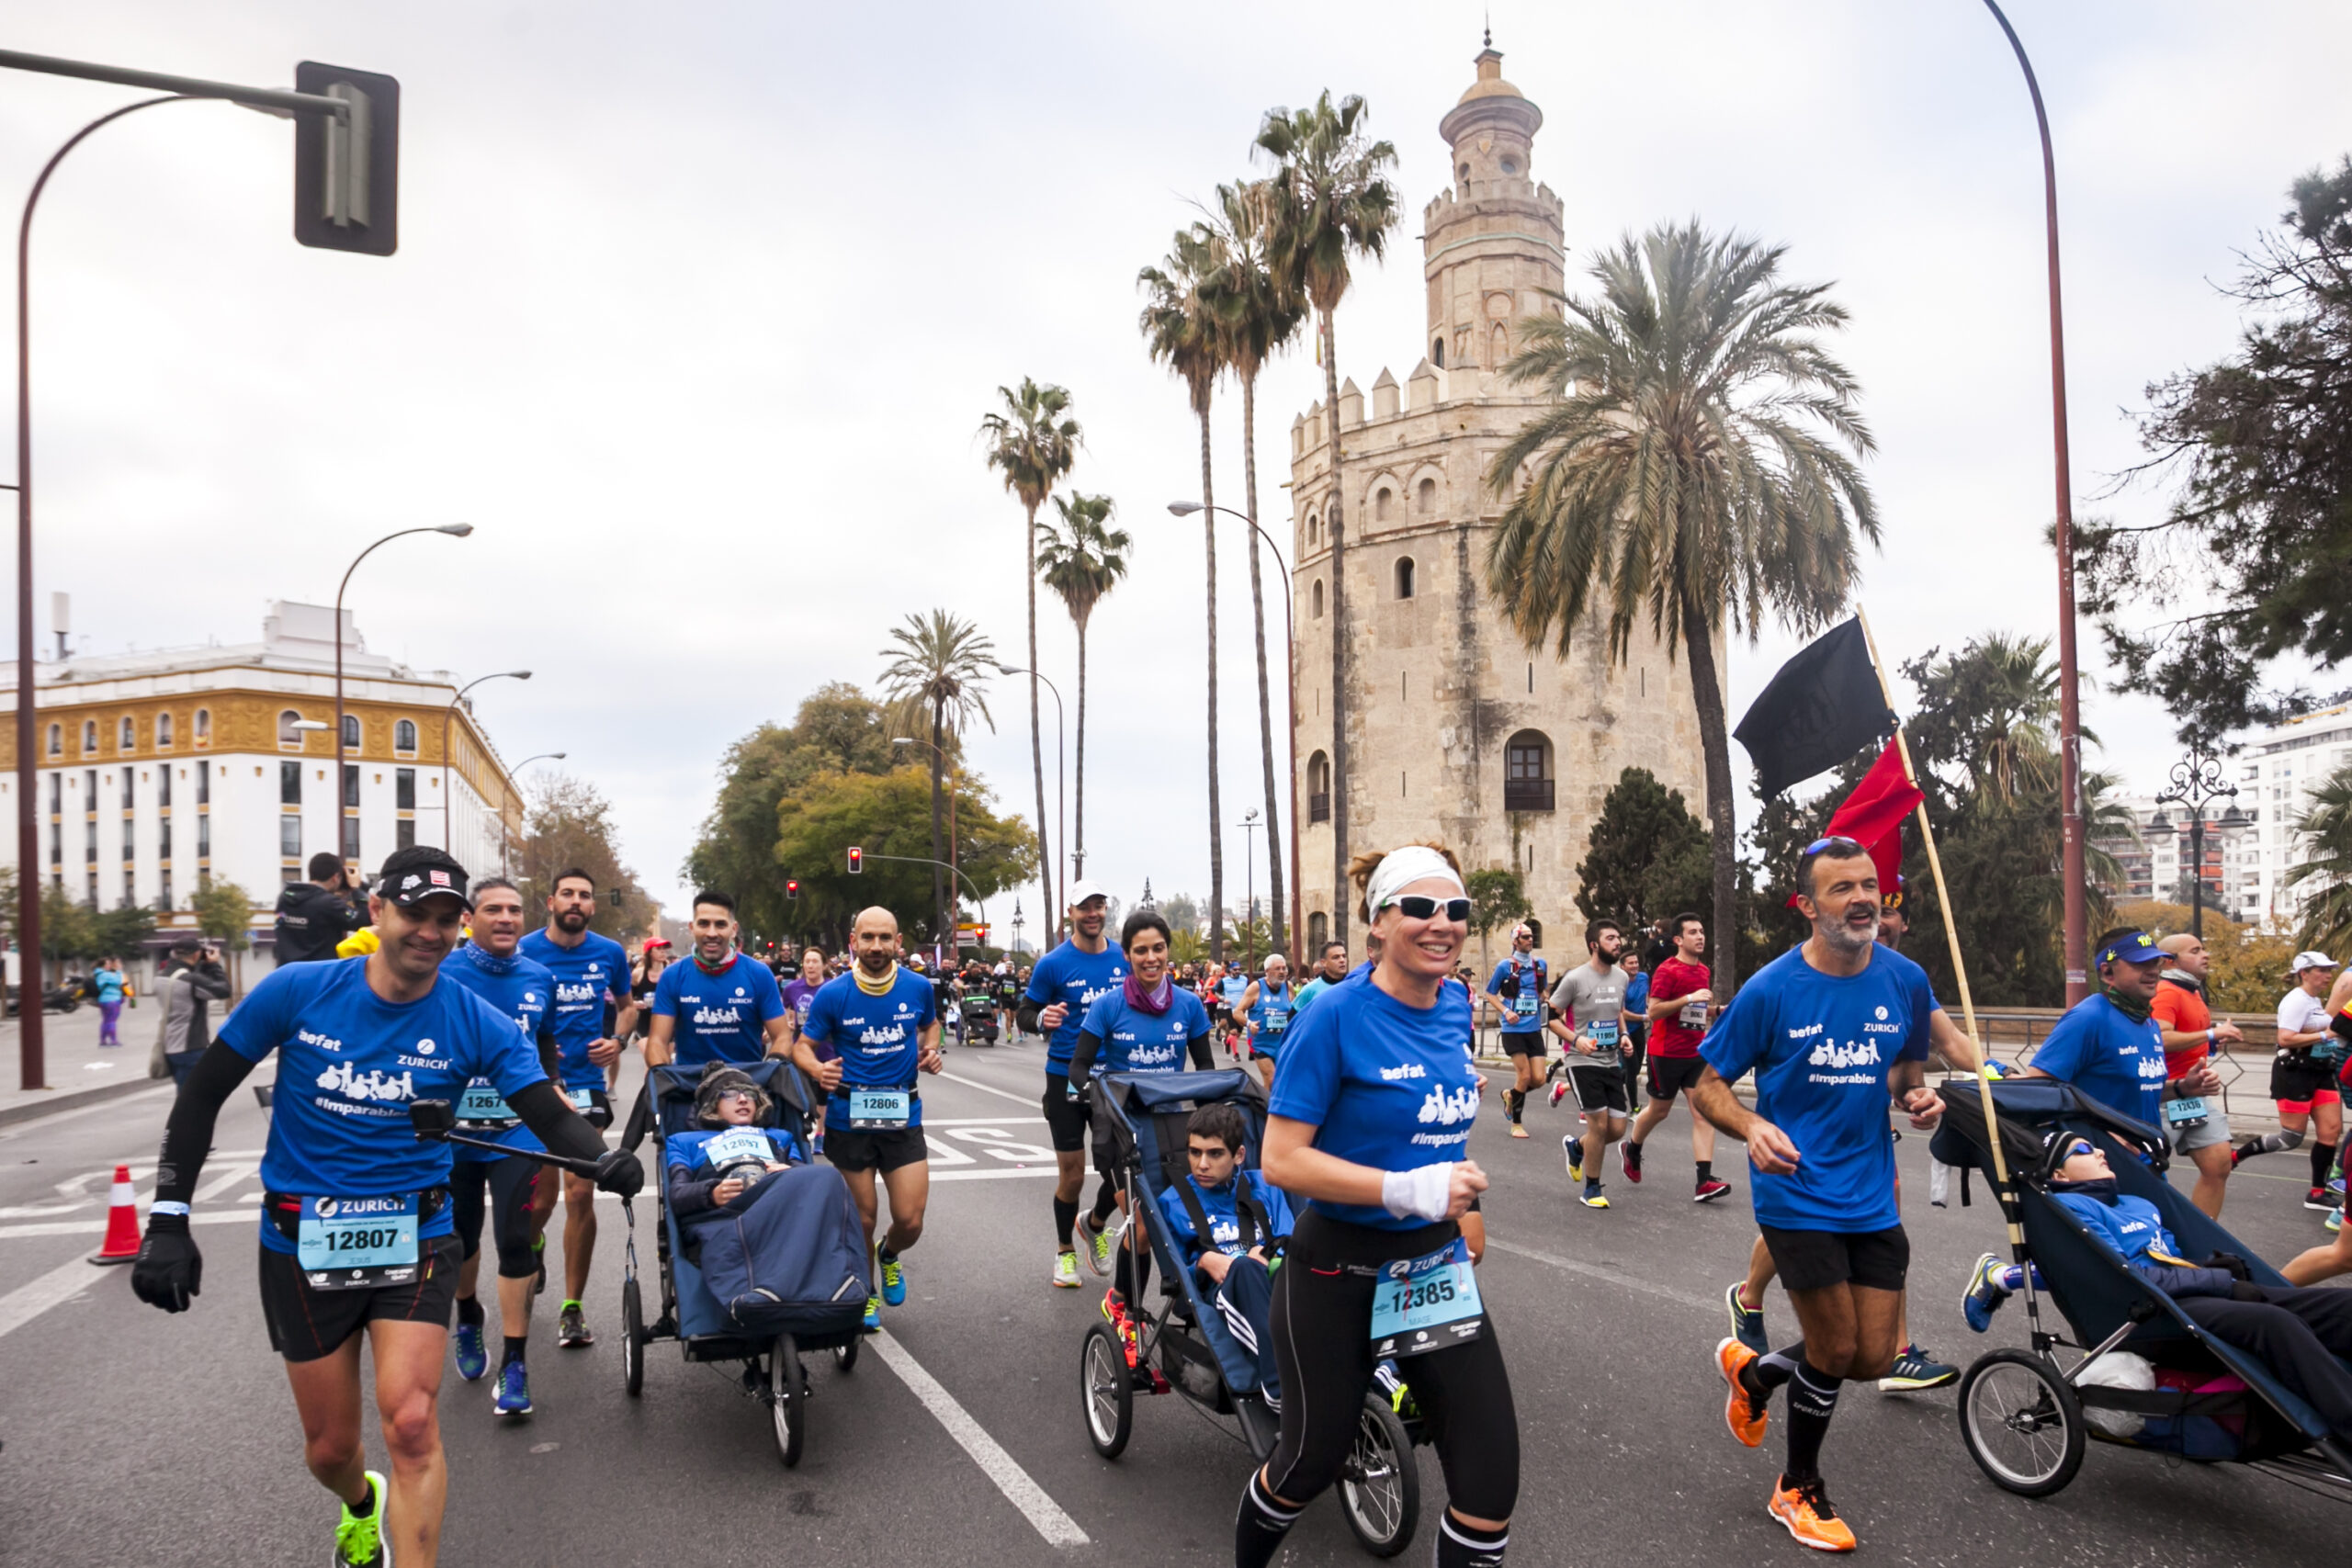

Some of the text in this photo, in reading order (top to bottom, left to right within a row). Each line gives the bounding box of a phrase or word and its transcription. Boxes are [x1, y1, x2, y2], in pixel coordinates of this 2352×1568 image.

[893, 1012, 917, 1021] ZURICH
[1790, 1022, 1824, 1039] aefat
[1863, 1022, 1901, 1033] ZURICH
[299, 1029, 342, 1053] aefat
[397, 1055, 450, 1070] ZURICH
[1381, 1063, 1427, 1080] aefat
[1808, 1073, 1877, 1086] #Imparables
[467, 1095, 502, 1108] 1267
[862, 1098, 899, 1110] 12806
[341, 1199, 405, 1213] ZURICH
[325, 1228, 399, 1251] 12807
[1392, 1279, 1455, 1314] 12385
